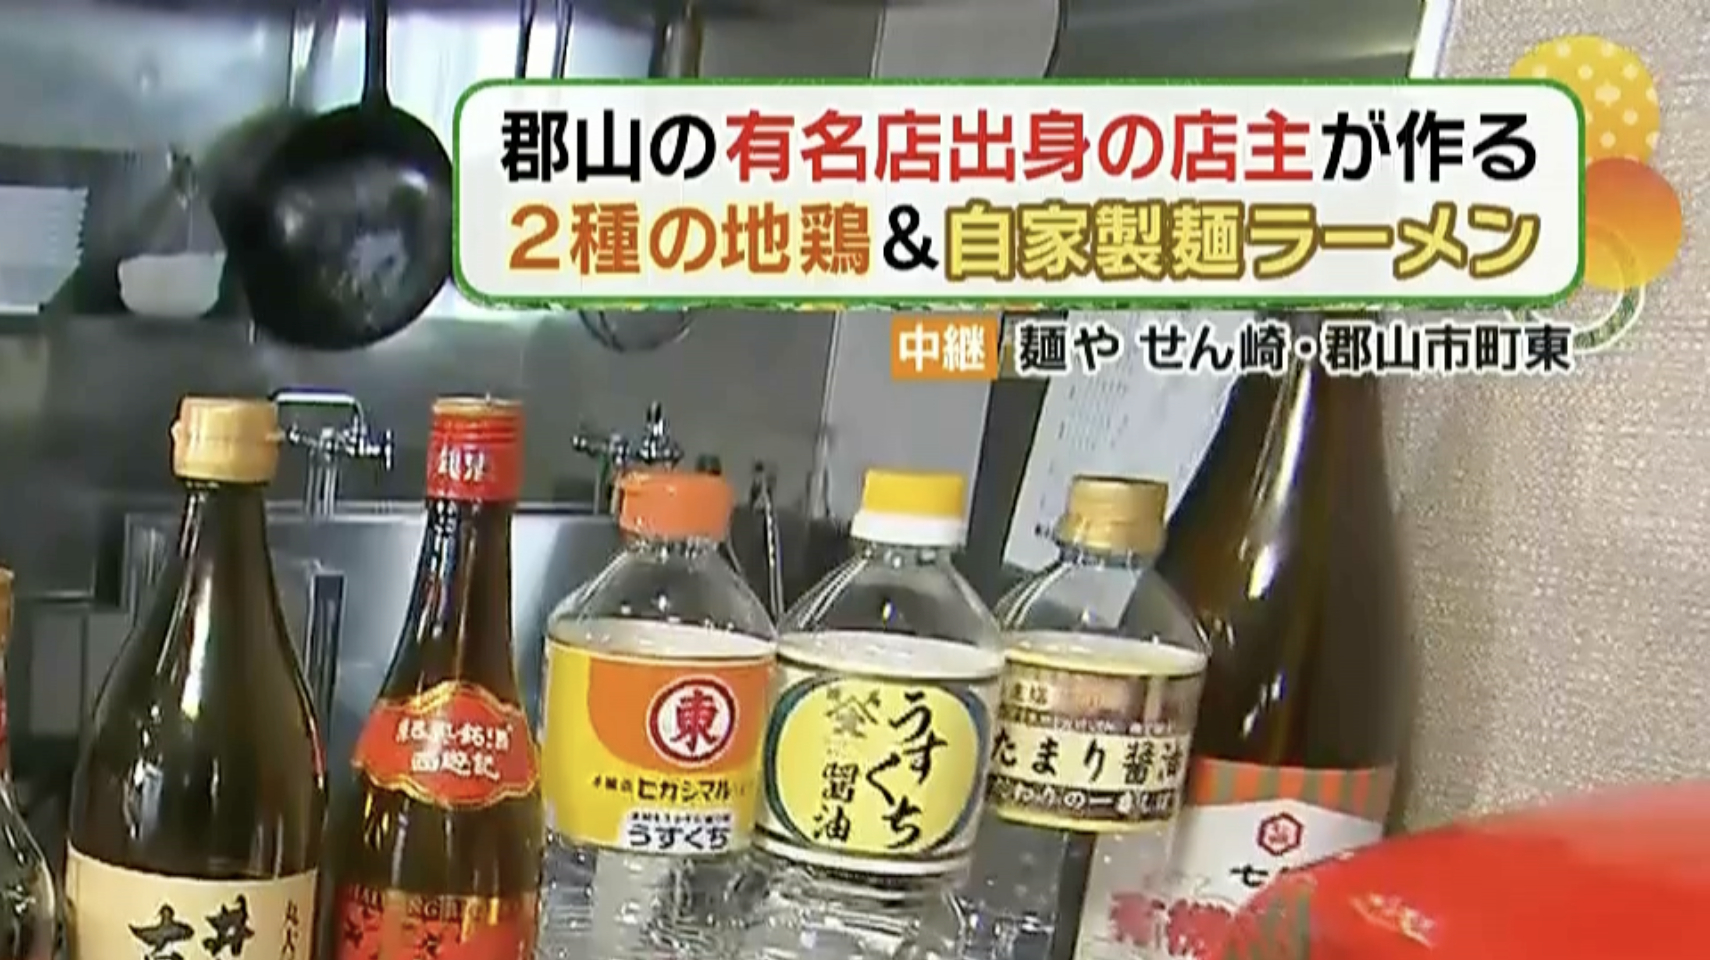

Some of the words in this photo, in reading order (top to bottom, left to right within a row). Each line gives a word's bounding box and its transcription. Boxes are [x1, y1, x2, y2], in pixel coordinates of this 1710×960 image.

[865, 690, 949, 850] うすくち
[628, 822, 732, 850] うすくち
